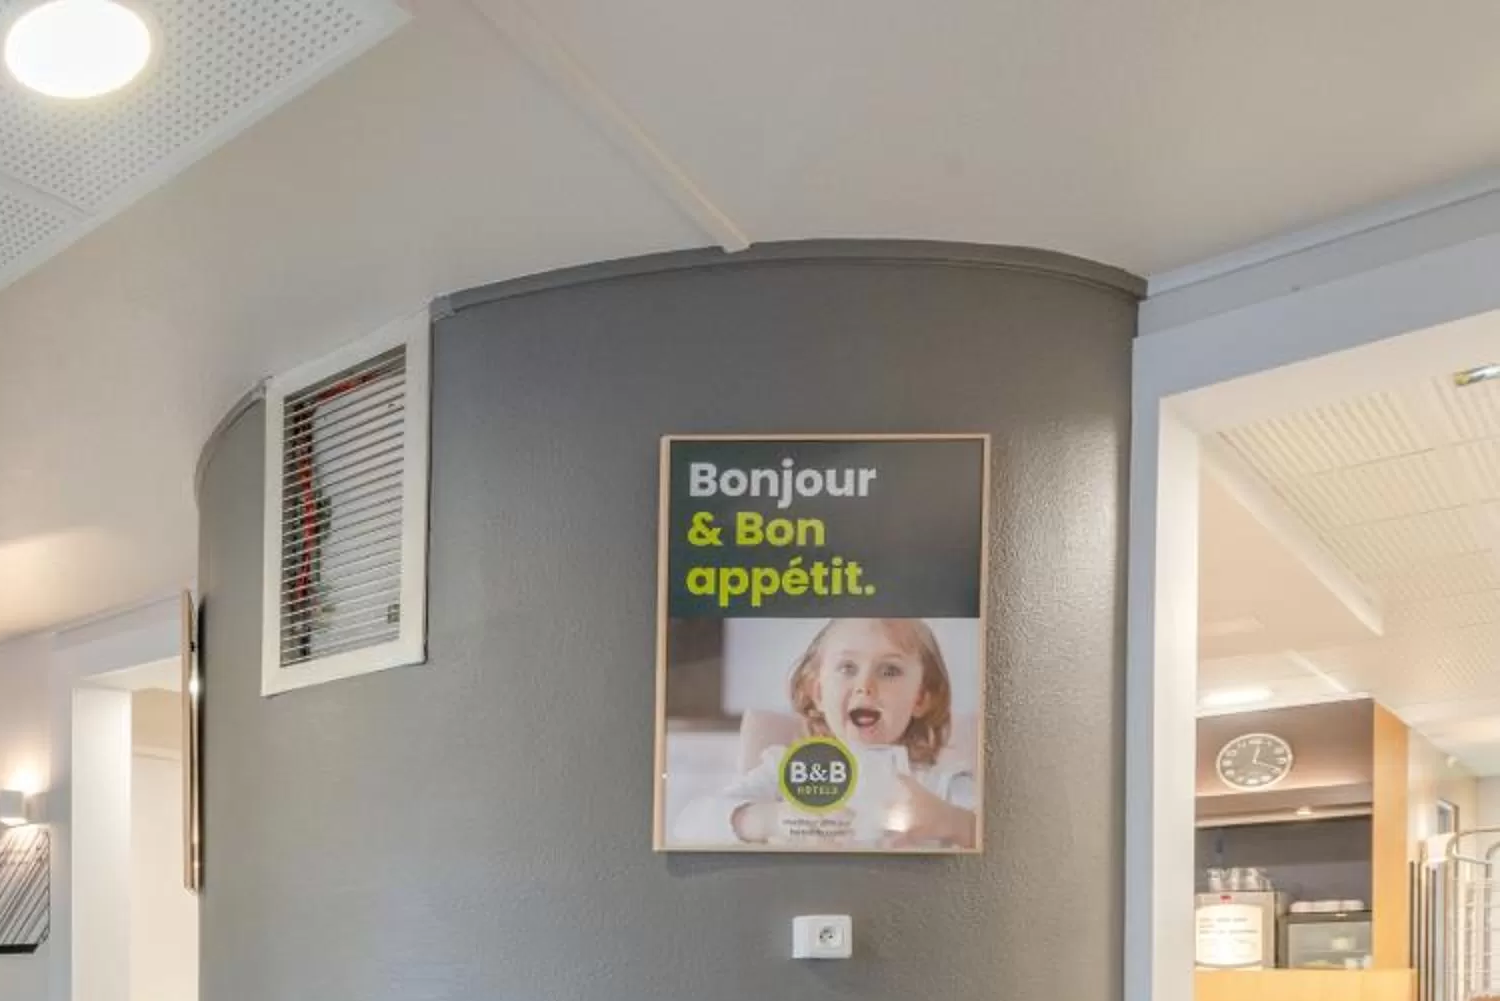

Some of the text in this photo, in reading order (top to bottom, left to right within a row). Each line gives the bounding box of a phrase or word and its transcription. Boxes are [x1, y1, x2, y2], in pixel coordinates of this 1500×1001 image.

[689, 457, 877, 509] Bonjour
[687, 511, 825, 546] & Bon
[686, 555, 876, 607] appétit.
[790, 761, 847, 783] B&B
